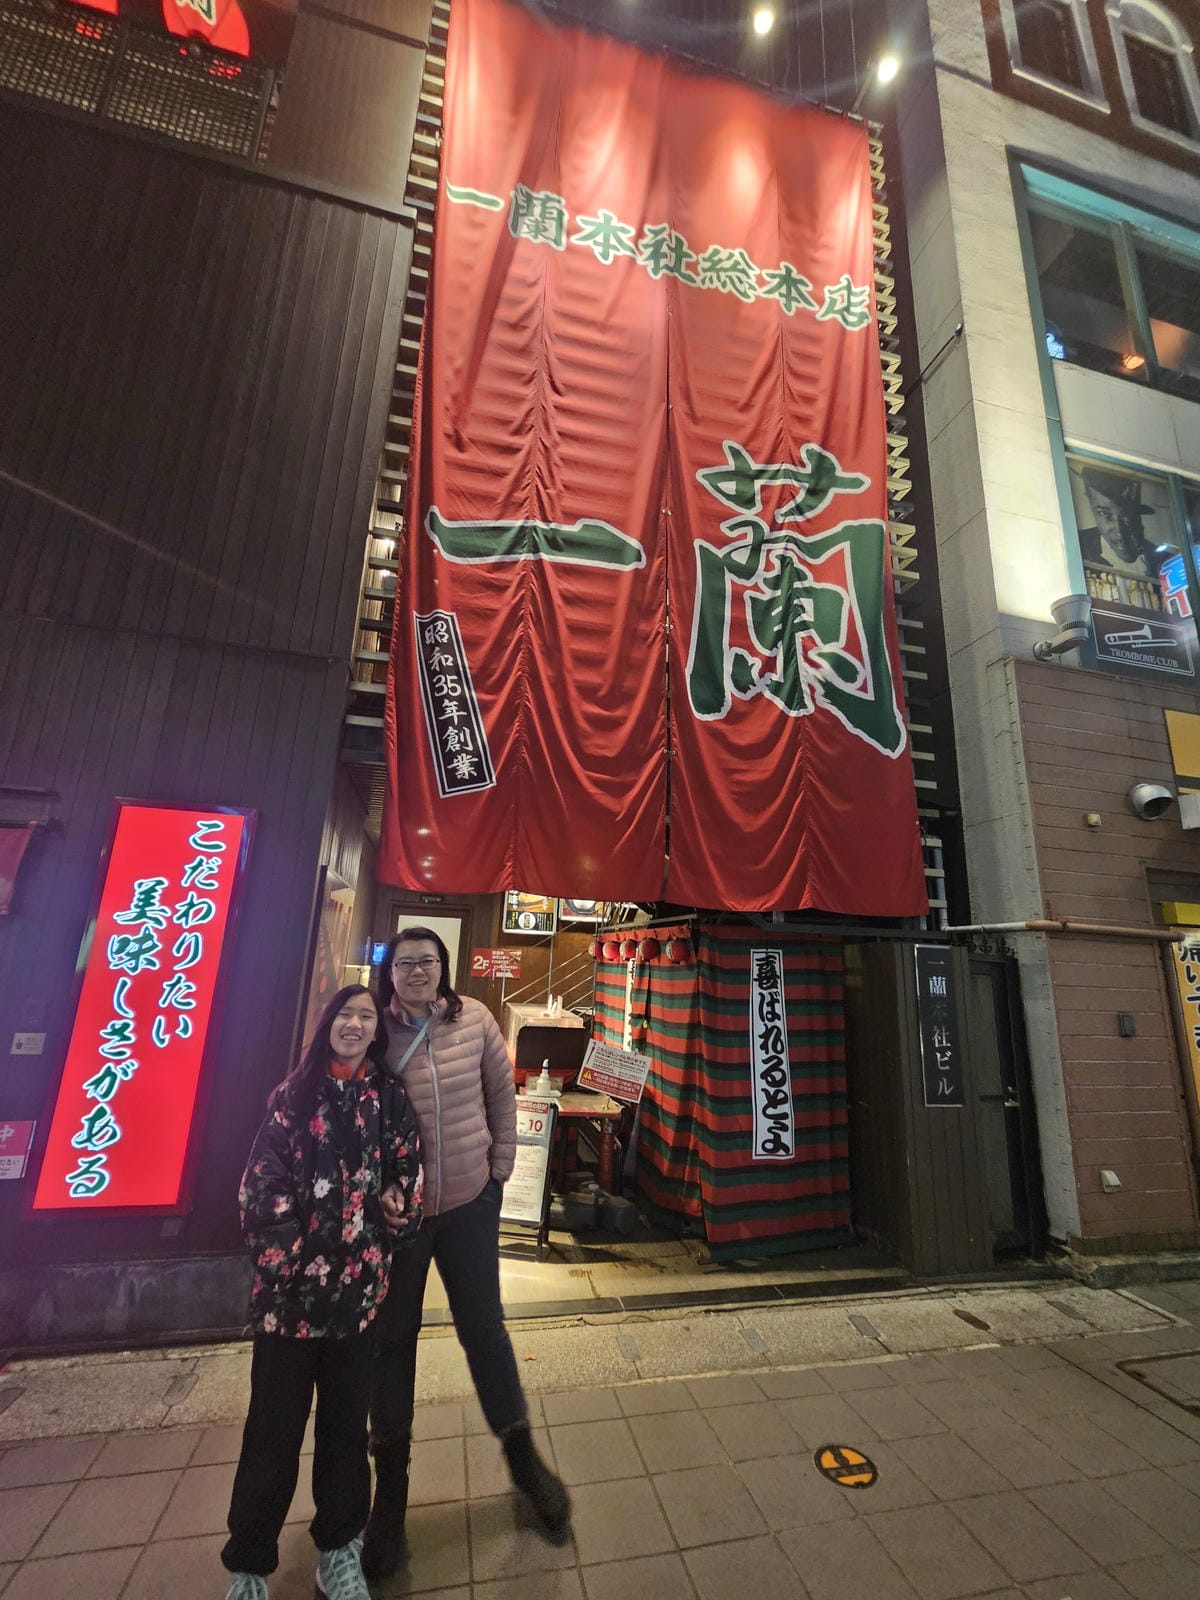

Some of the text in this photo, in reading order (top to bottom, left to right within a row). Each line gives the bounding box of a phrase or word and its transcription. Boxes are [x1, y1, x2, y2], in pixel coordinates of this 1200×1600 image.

[446, 179, 872, 330] 一蘭本社総本店
[425, 440, 907, 759] 一蘭
[1109, 647, 1179, 668] TROMBONE CLUB
[423, 620, 480, 781] 昭和35年創業
[151, 819, 227, 1048] こだわりたい
[472, 955, 490, 970] 2F
[66, 876, 170, 1198] 美味しさがある
[927, 960, 954, 1097] 一蘭本社ビル
